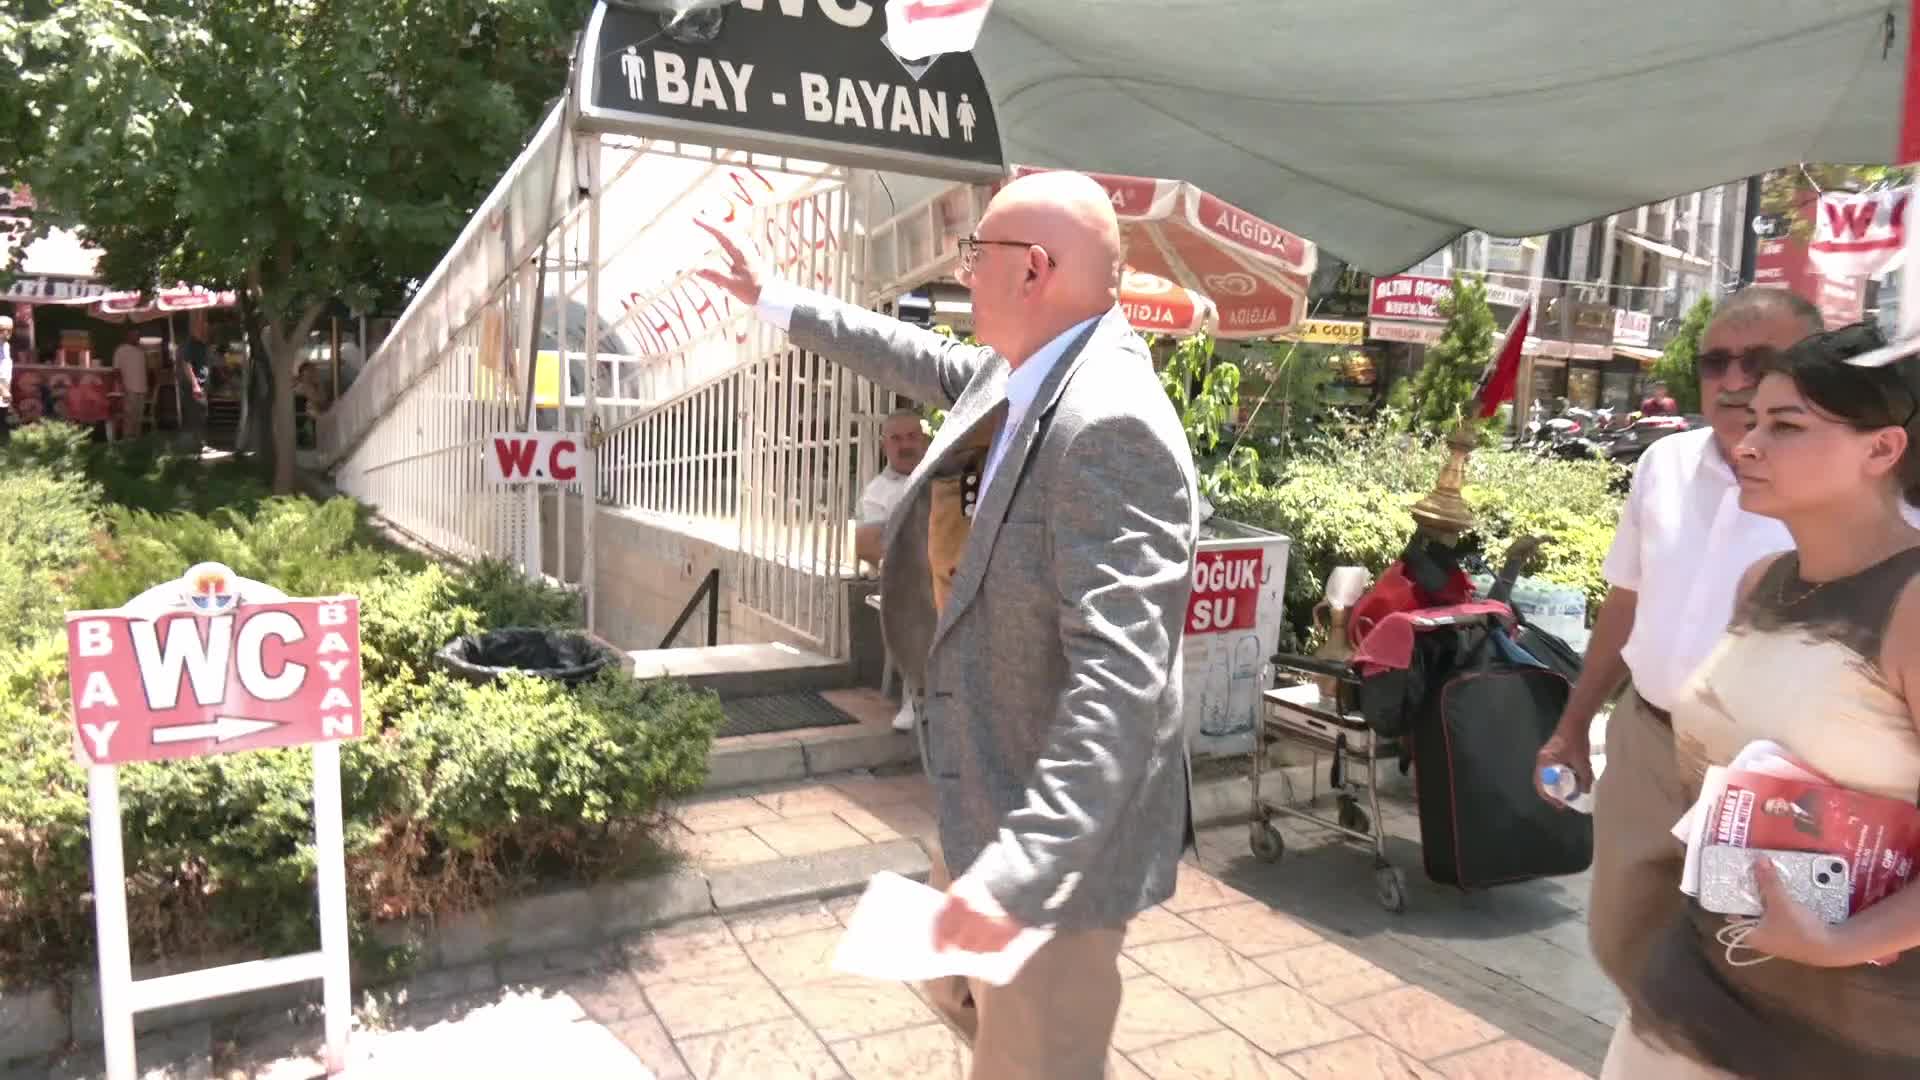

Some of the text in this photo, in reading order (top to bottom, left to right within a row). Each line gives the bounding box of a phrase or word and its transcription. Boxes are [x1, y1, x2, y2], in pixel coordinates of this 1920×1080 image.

[652, 50, 754, 113] BAY
[800, 72, 950, 139] BAYAN
[1322, 325, 1360, 337] GOLD
[1192, 553, 1259, 592] OĞUK
[1192, 597, 1236, 630] SU
[77, 620, 121, 757] BAY
[129, 610, 308, 711] WC
[316, 603, 354, 737] BAYAN
